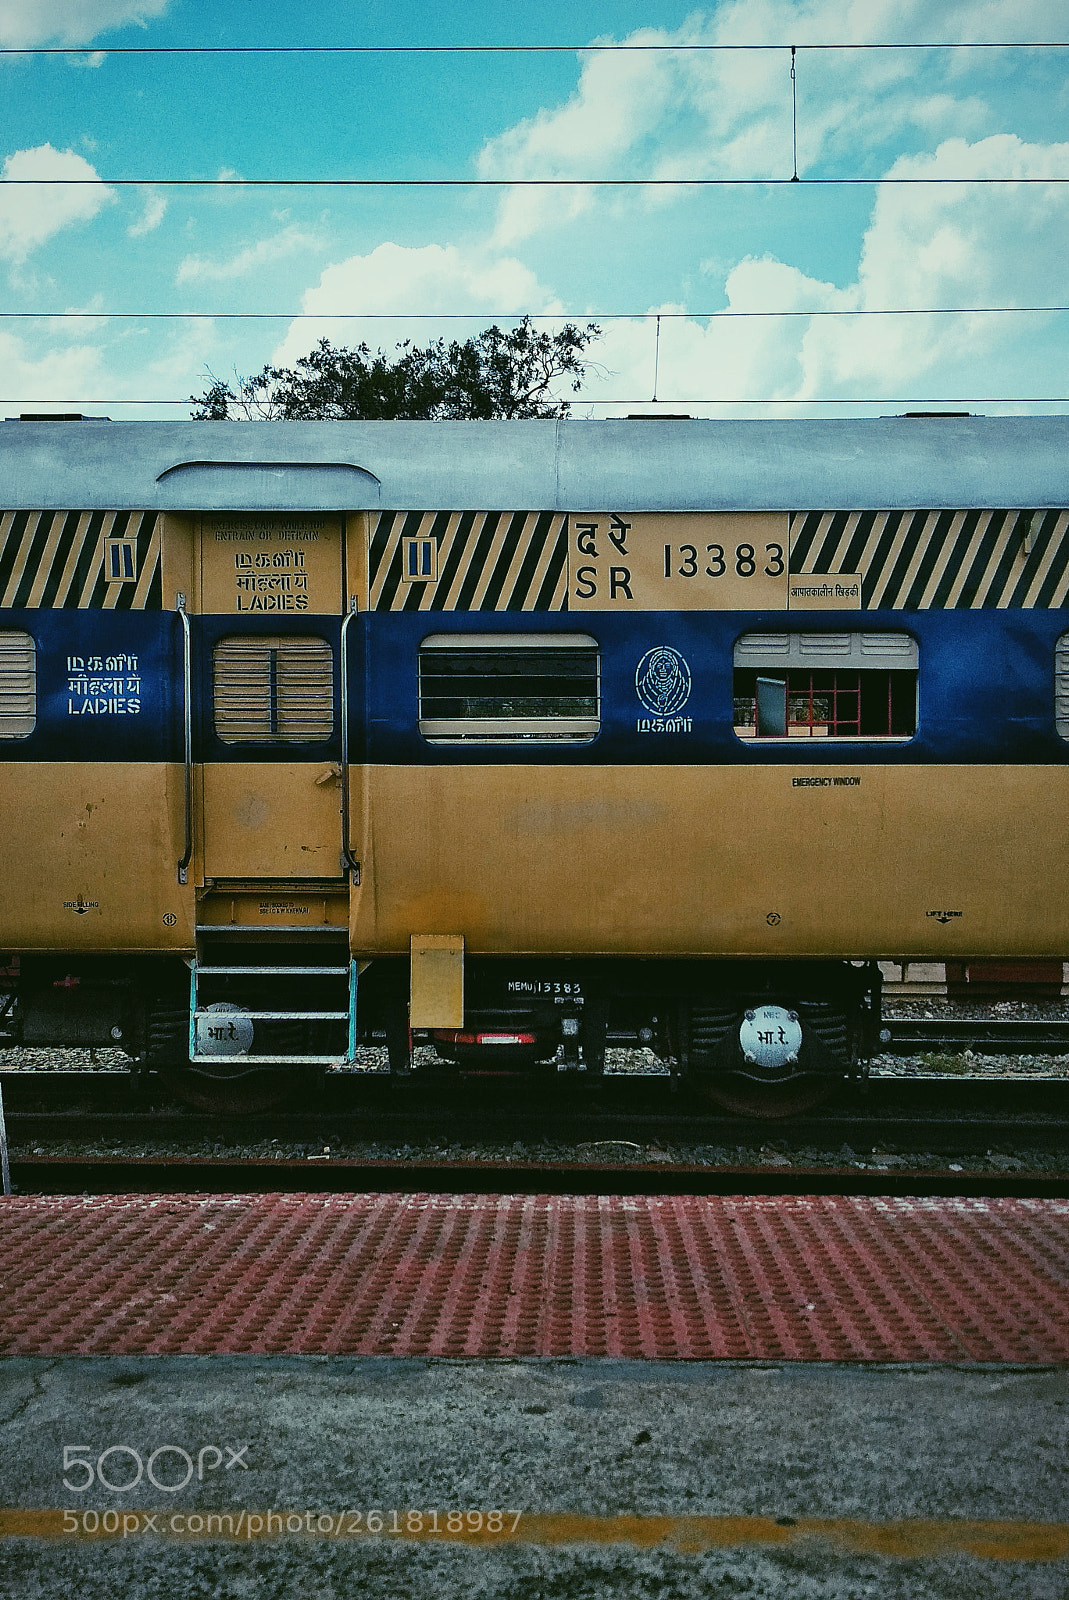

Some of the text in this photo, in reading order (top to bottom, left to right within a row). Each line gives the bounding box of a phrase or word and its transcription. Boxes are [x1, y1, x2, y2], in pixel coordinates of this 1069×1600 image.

[215, 531, 319, 541] ENTRAIN OR DETRAIN
[235, 549, 305, 569] மகளிர்
[663, 542, 785, 579] 13383
[790, 583, 834, 597] आपातकालीन
[236, 594, 309, 611] LADIES
[67, 653, 139, 672] மகளிர்
[68, 698, 141, 715] LADIES
[792, 776, 861, 787] EMERGENCY WINDOW
